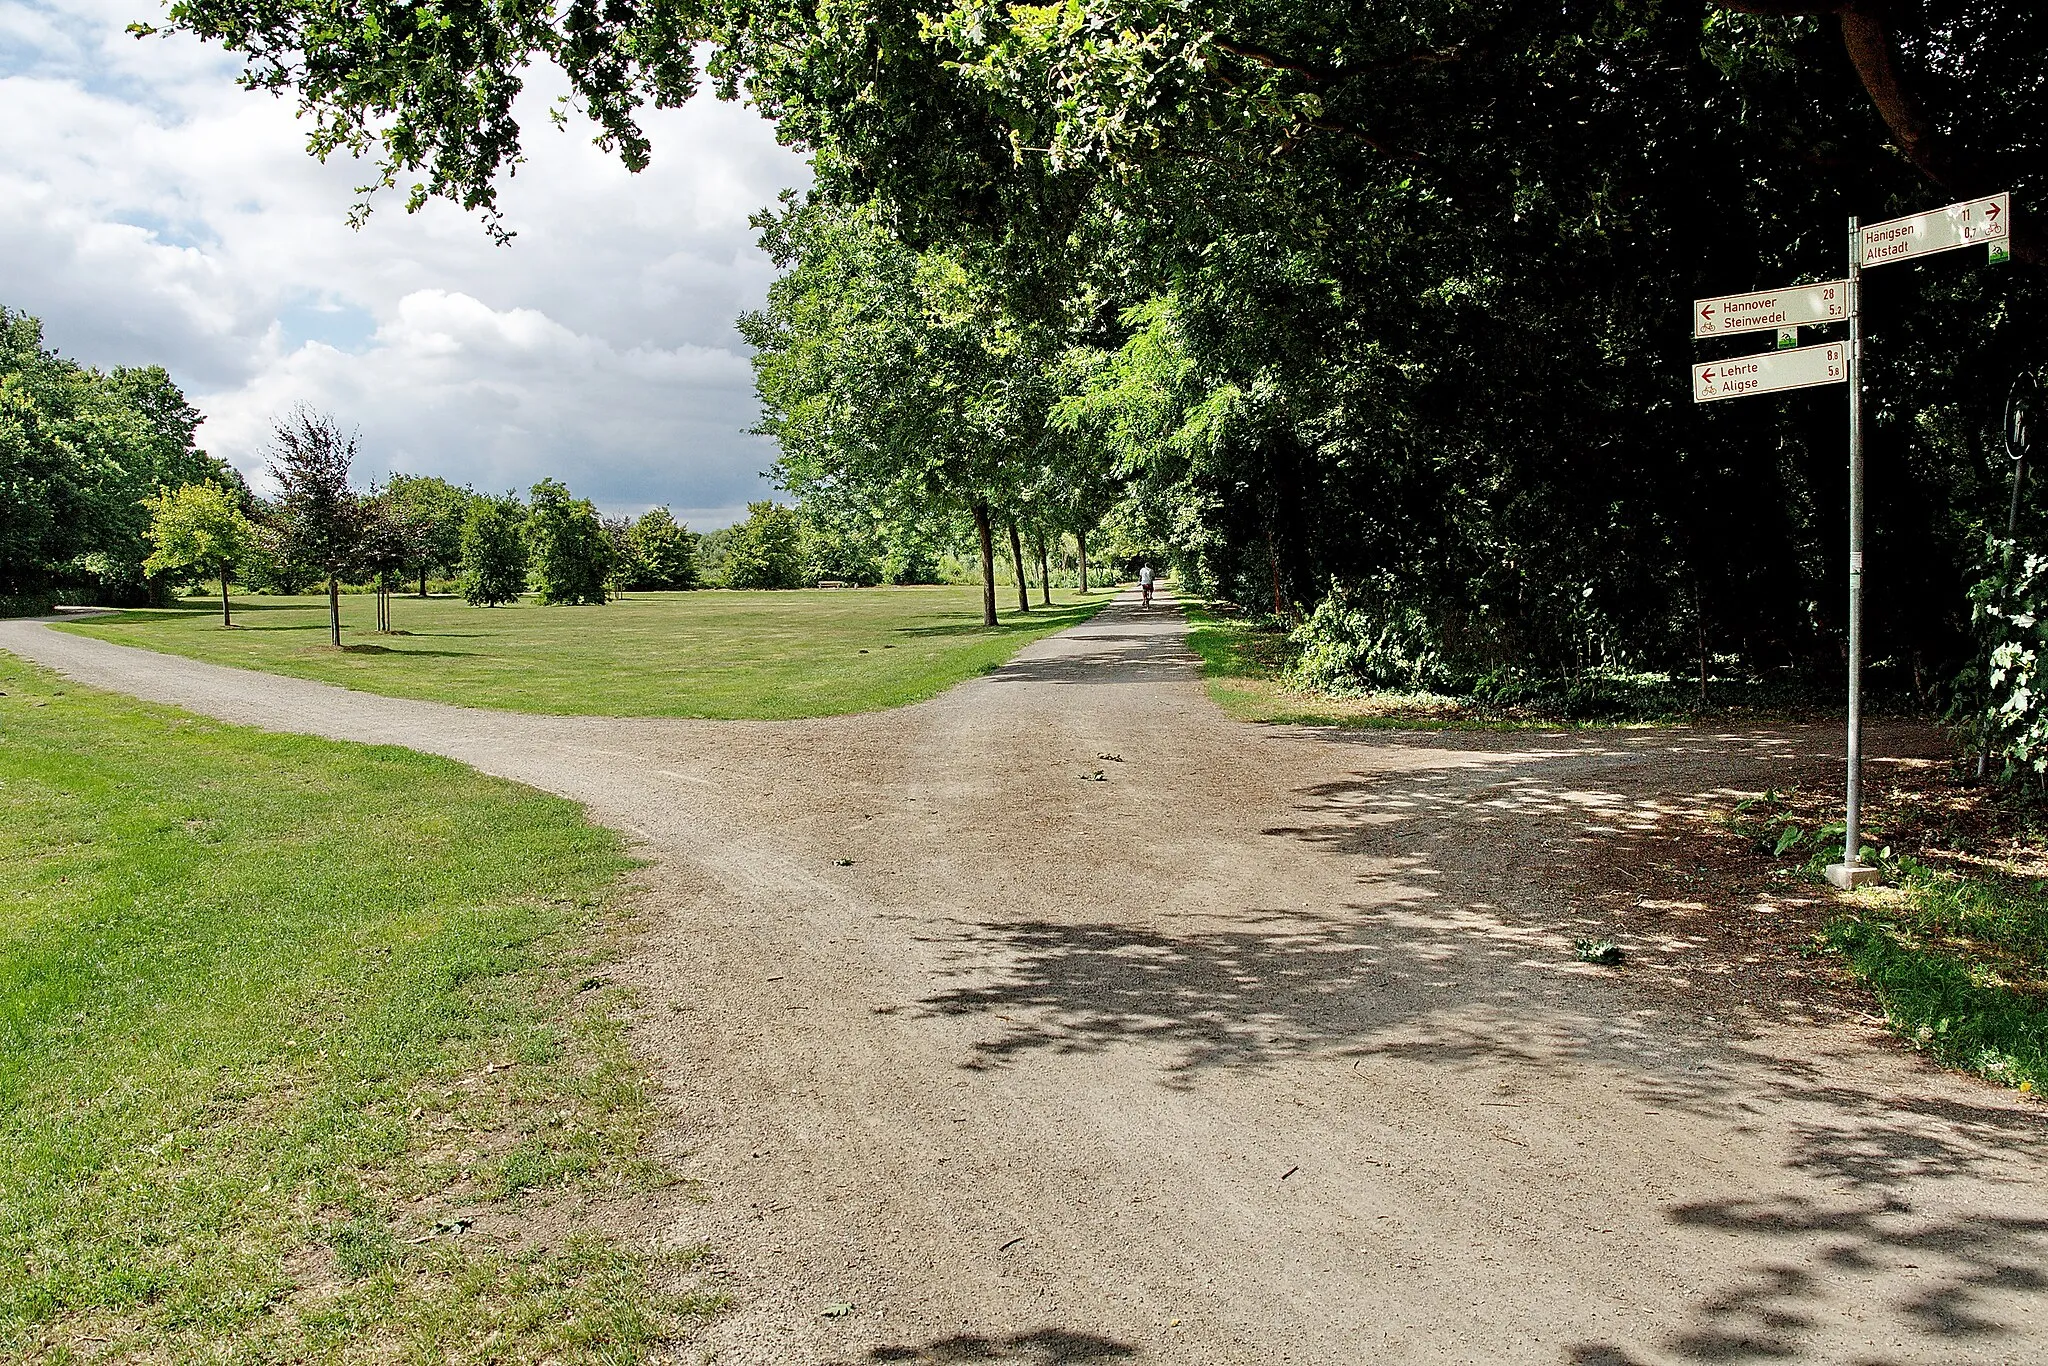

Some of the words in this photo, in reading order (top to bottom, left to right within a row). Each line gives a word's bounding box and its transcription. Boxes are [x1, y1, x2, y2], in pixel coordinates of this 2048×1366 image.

[1866, 225, 1914, 244] Hänigsen
[1962, 209, 1970, 221] 11
[1867, 241, 1908, 260] Altstadt
[1724, 299, 1776, 313] Hannover
[1823, 288, 1834, 300] 28
[1724, 311, 1786, 328] Steinwedel
[1721, 363, 1758, 377] Lehrte
[1722, 380, 1758, 392] Aligse
